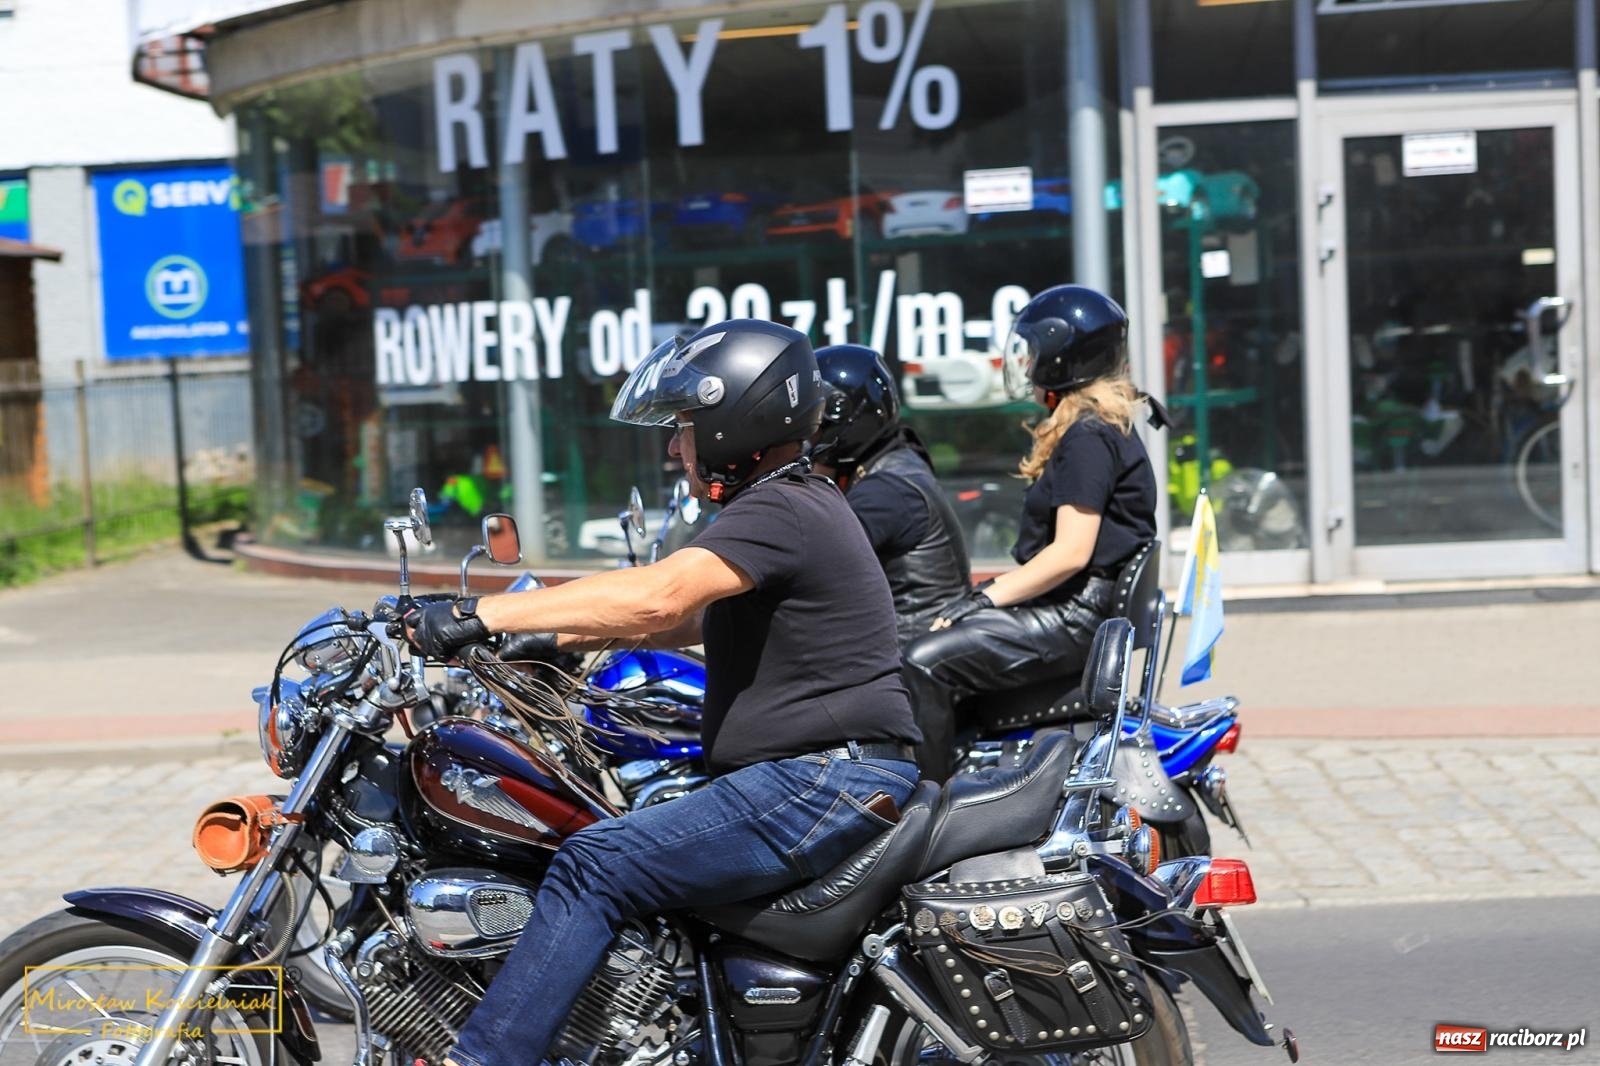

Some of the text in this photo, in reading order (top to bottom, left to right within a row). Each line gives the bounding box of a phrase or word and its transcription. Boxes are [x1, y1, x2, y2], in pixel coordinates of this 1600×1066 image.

[433, 0, 960, 173] RATY 1%
[374, 297, 571, 385] ROWERY
[590, 288, 651, 377] od
